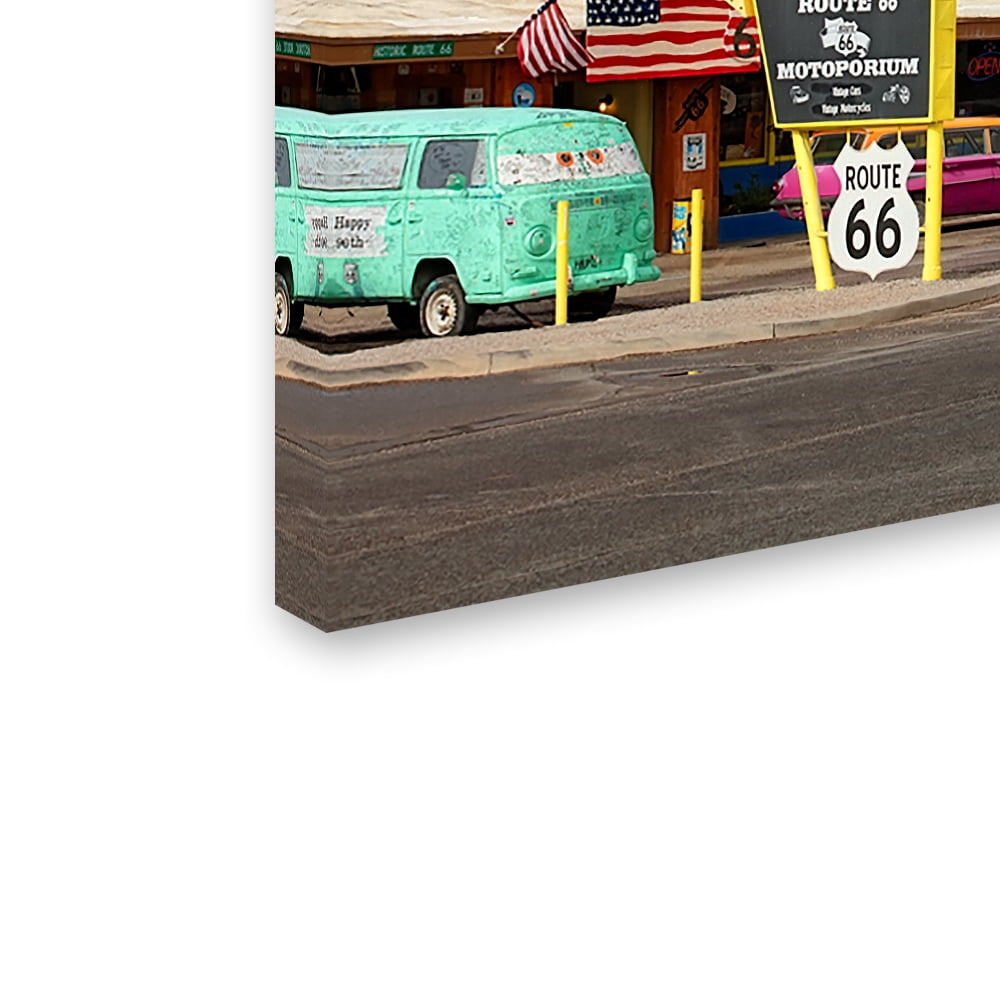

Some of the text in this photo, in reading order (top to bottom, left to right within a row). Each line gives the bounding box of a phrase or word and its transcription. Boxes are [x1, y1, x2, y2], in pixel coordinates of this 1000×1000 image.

[412, 43, 435, 55] ROUTE
[440, 42, 453, 55] 66
[838, 34, 855, 51] 66
[776, 57, 920, 80] MOTOPORIUM
[845, 163, 902, 191] ROUTE
[334, 215, 372, 231] Happy
[845, 197, 902, 260] 66
